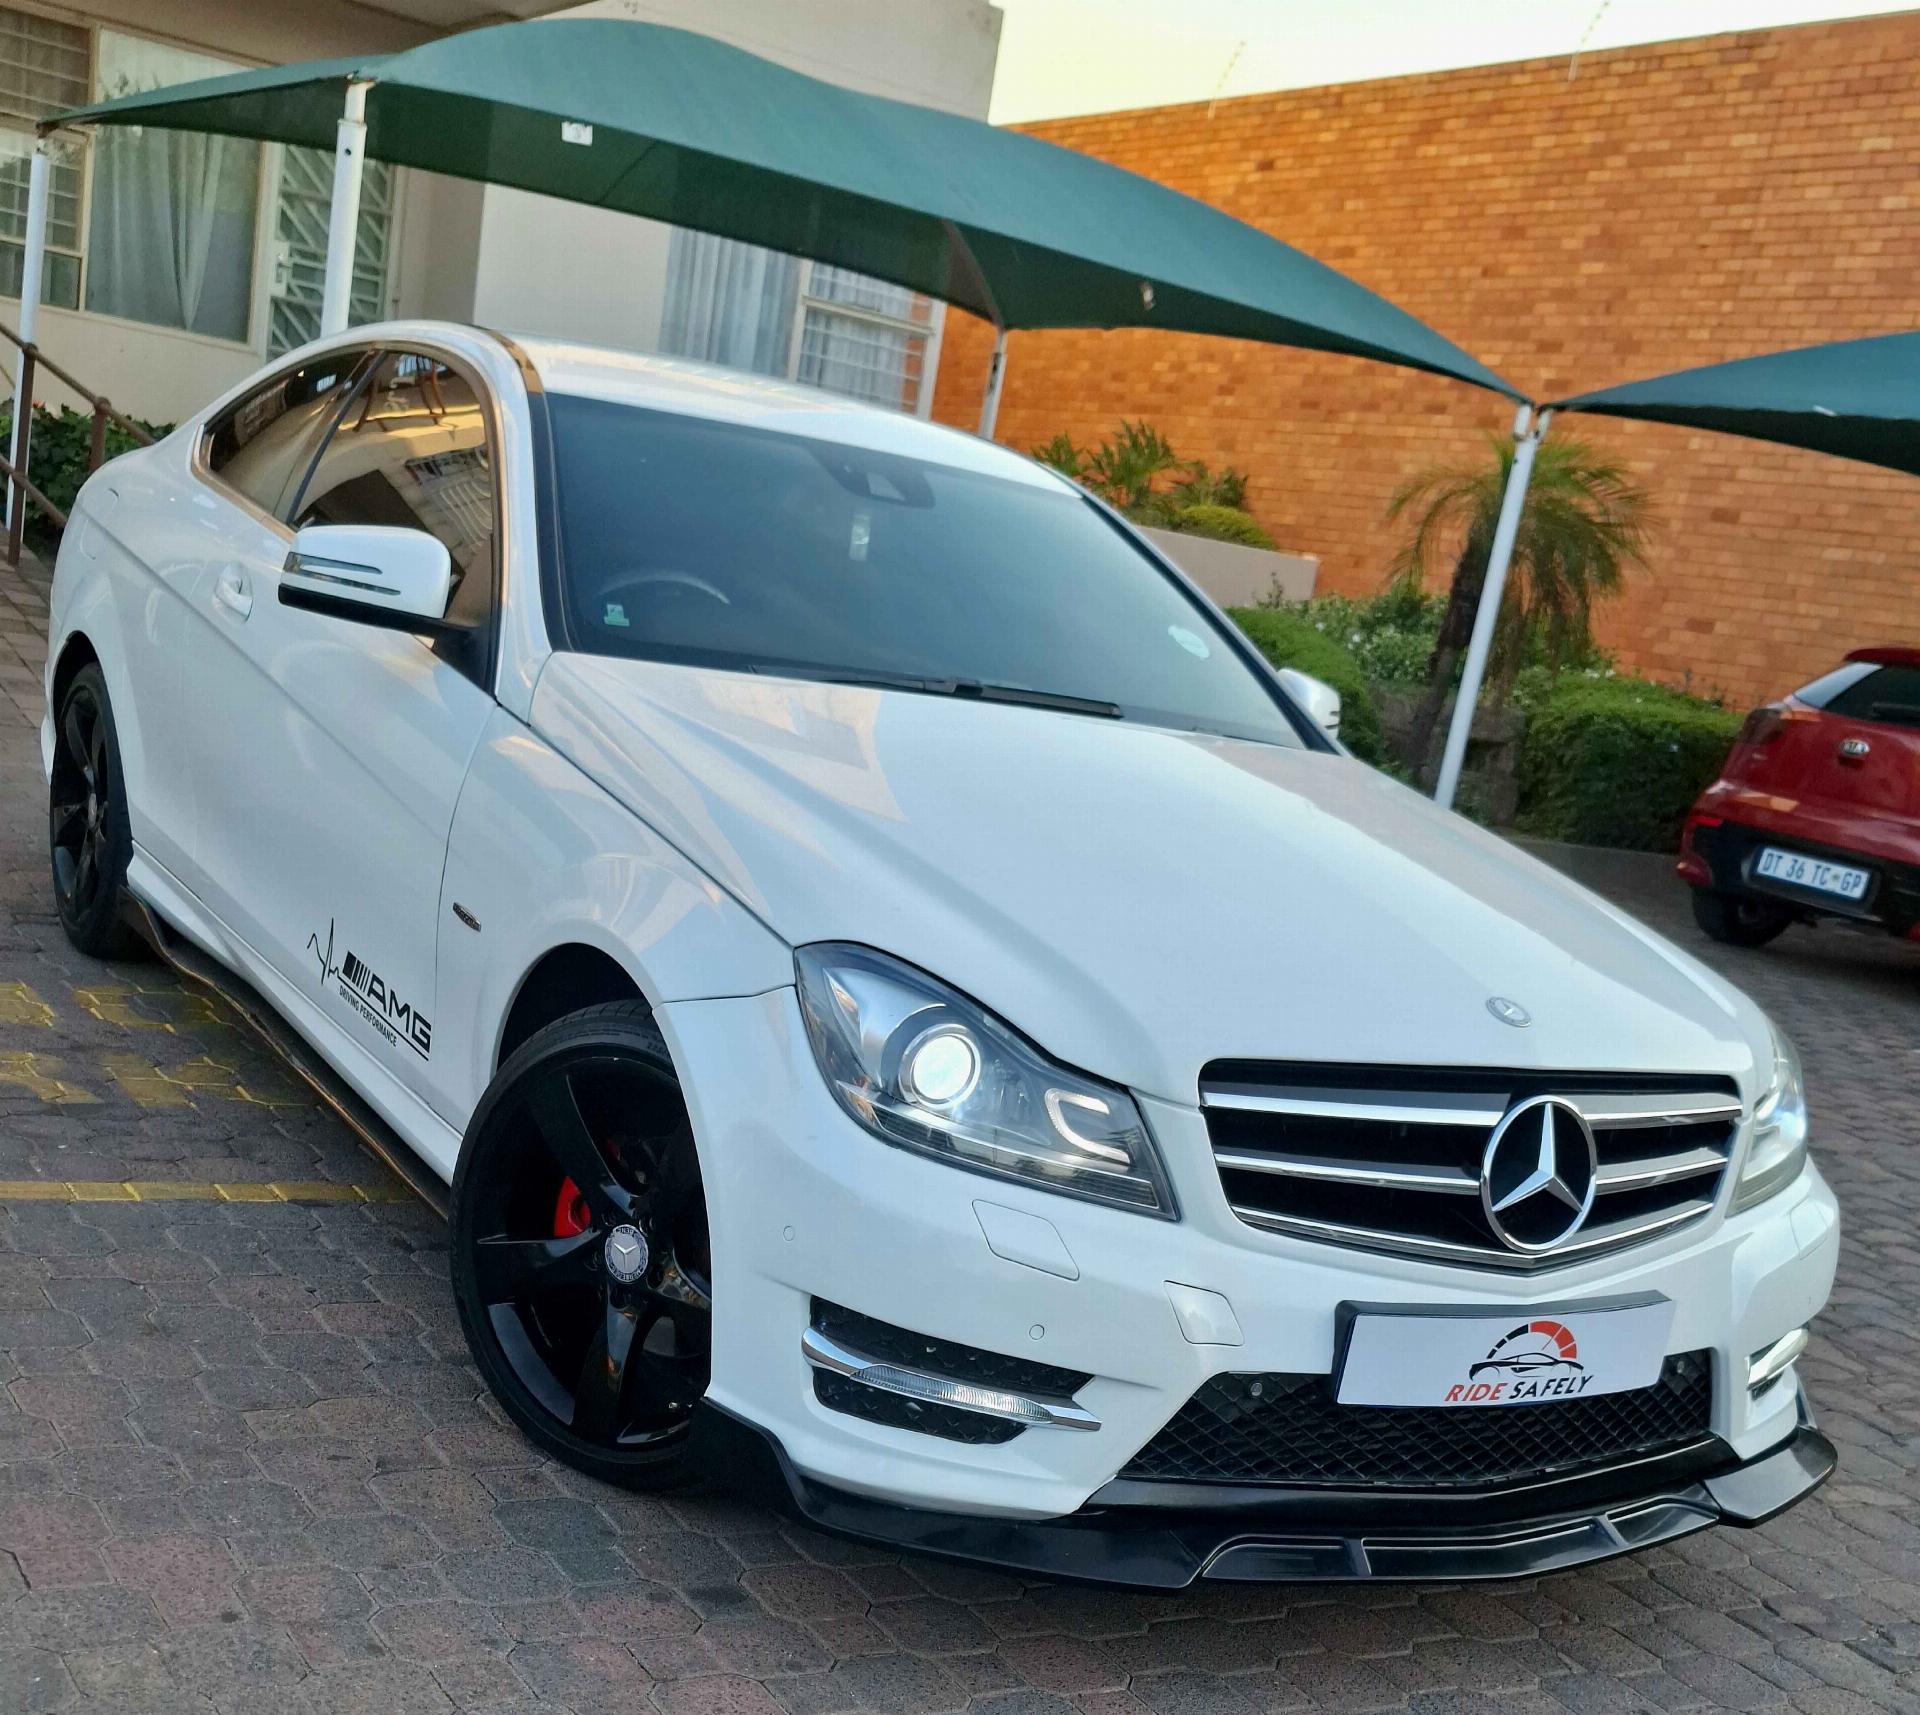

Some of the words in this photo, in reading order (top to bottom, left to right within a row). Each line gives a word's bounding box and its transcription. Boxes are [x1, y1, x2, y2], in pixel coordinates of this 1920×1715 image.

[1762, 852, 1783, 873] DT
[1786, 858, 1806, 880] 36
[1812, 864, 1831, 886] TC
[1840, 871, 1862, 893] GP
[339, 985, 360, 1012] DRIVING
[359, 1004, 398, 1048] PERFORMANCE
[367, 973, 432, 1053] AMG
[1444, 1382, 1508, 1402] RIDE
[1508, 1374, 1595, 1400] SAFELY
